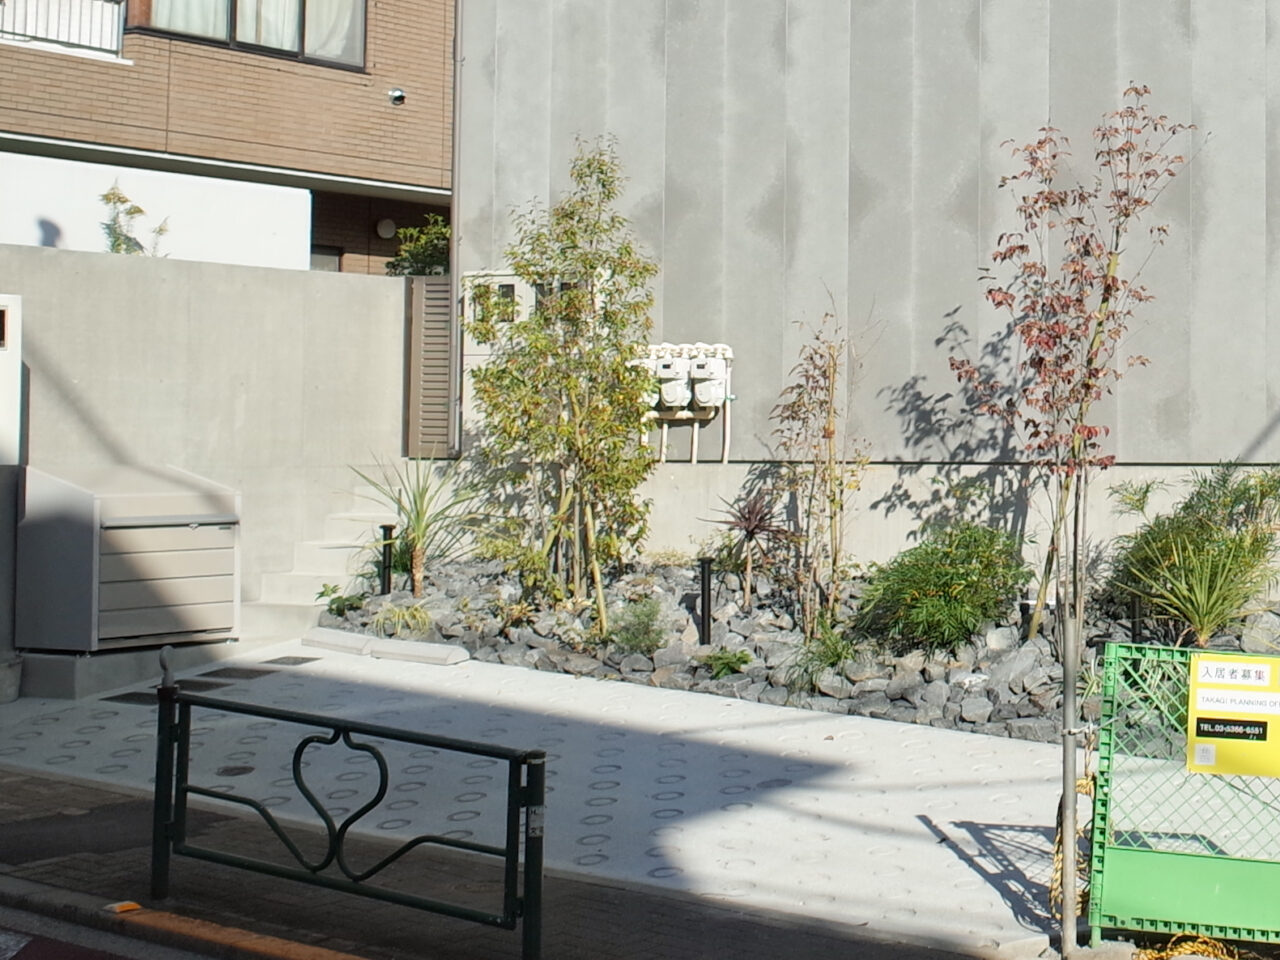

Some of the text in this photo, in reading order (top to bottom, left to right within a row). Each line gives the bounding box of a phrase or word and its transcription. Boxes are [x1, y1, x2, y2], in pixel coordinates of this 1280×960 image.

[1202, 666, 1265, 681] 入居者募集
[1202, 696, 1228, 705] TAKAGI
[1230, 698, 1267, 707] PLANNING
